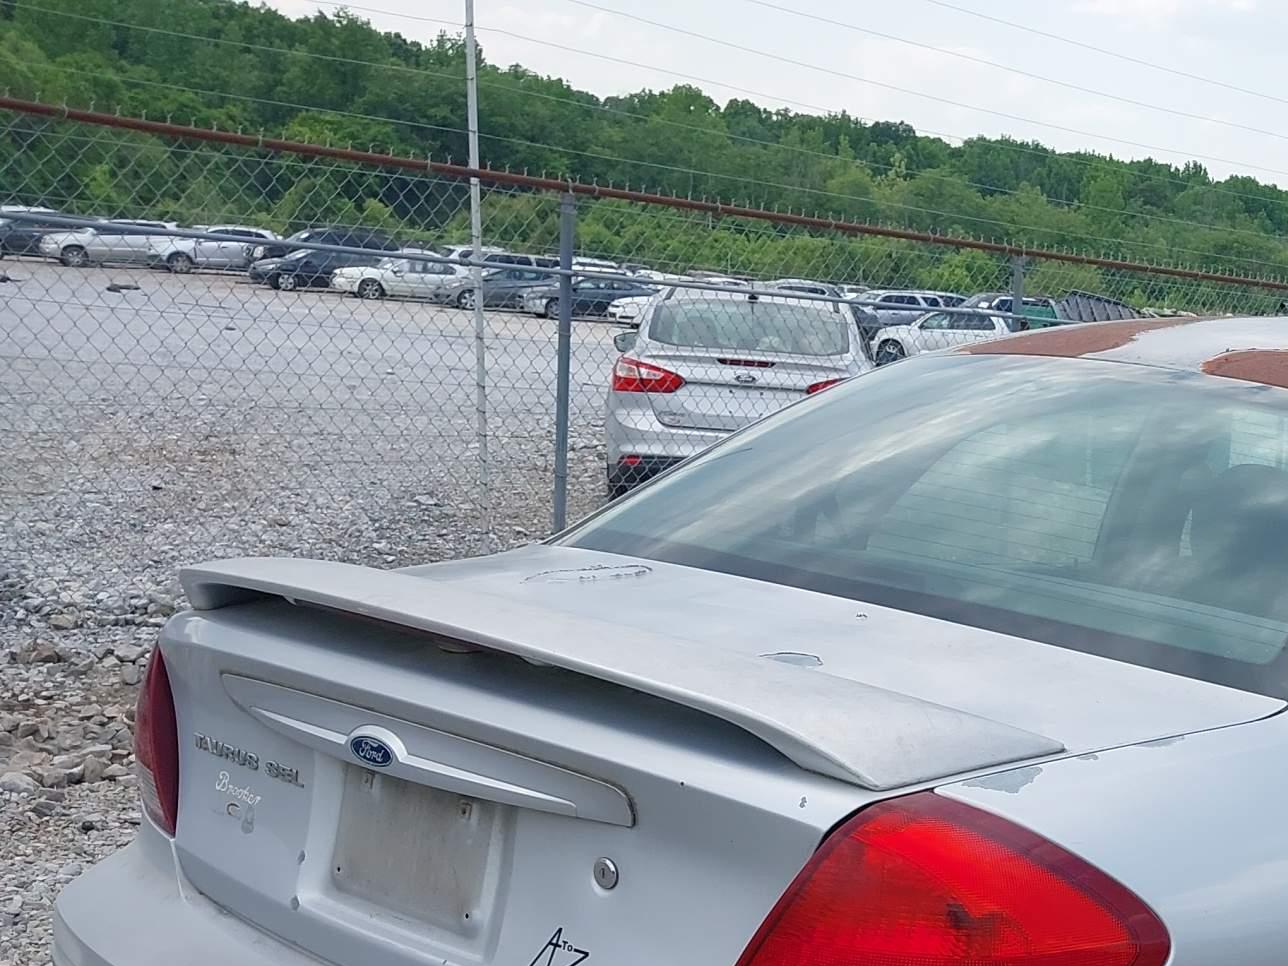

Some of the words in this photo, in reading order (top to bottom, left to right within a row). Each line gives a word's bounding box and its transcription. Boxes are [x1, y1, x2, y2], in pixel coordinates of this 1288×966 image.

[193, 731, 260, 771] TAURUS
[265, 760, 305, 789] SEL
[358, 740, 385, 763] Ford
[562, 940, 573, 953] To
